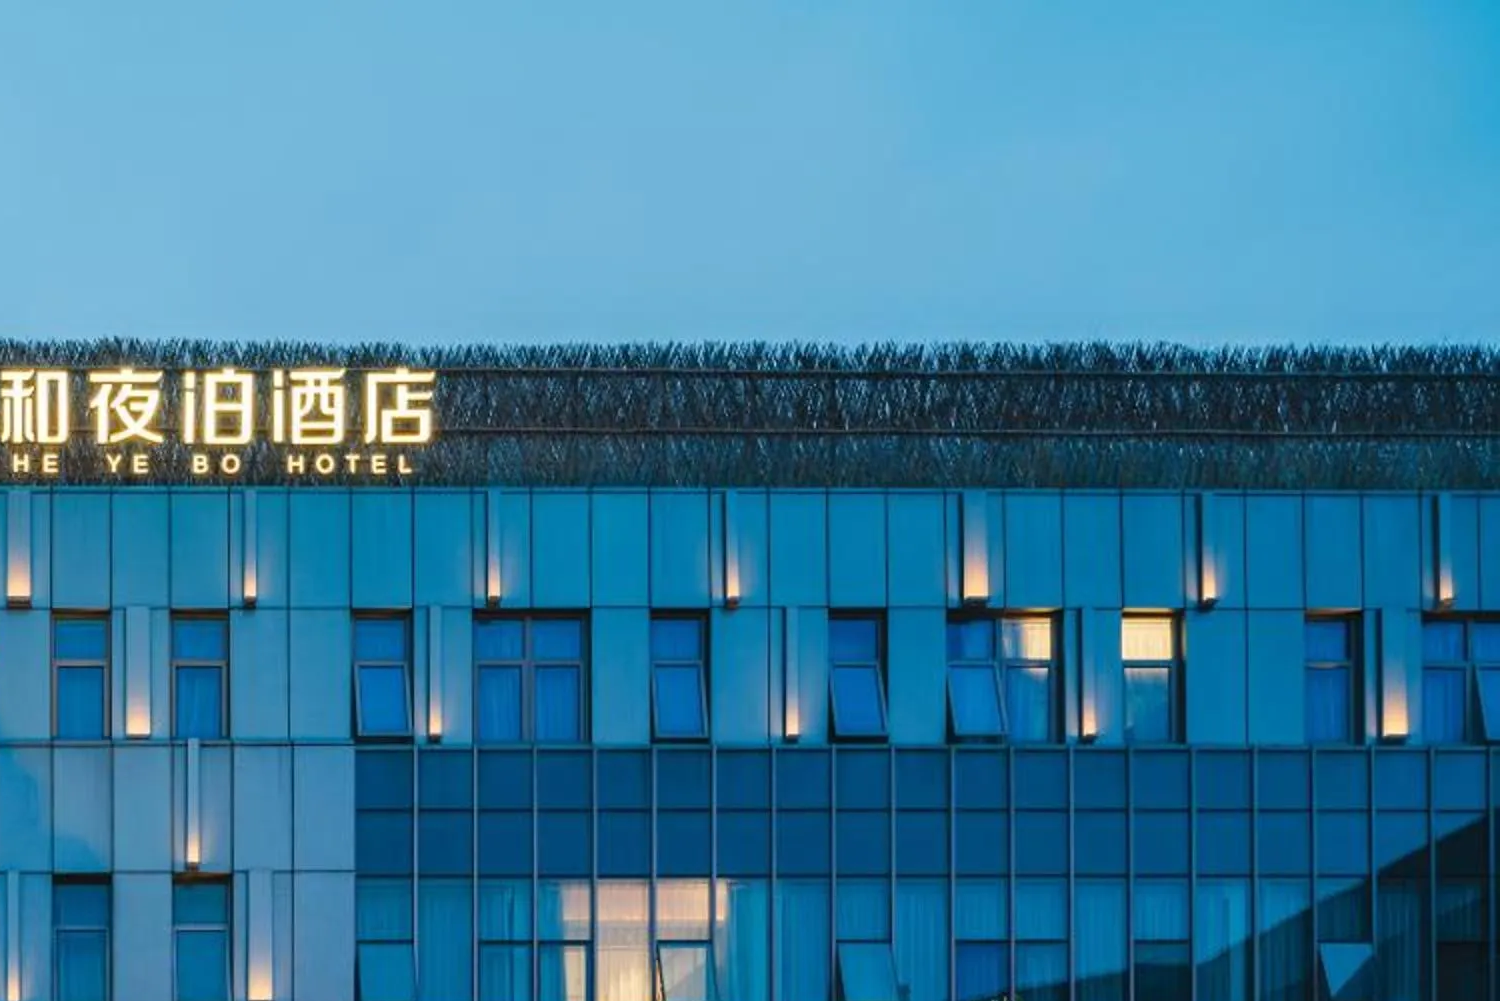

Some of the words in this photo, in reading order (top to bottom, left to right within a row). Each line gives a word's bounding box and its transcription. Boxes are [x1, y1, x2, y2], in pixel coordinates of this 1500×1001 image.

[12, 453, 60, 474] HE
[106, 454, 150, 474] YE
[193, 454, 241, 474] BO
[287, 454, 413, 475] HOTEL
